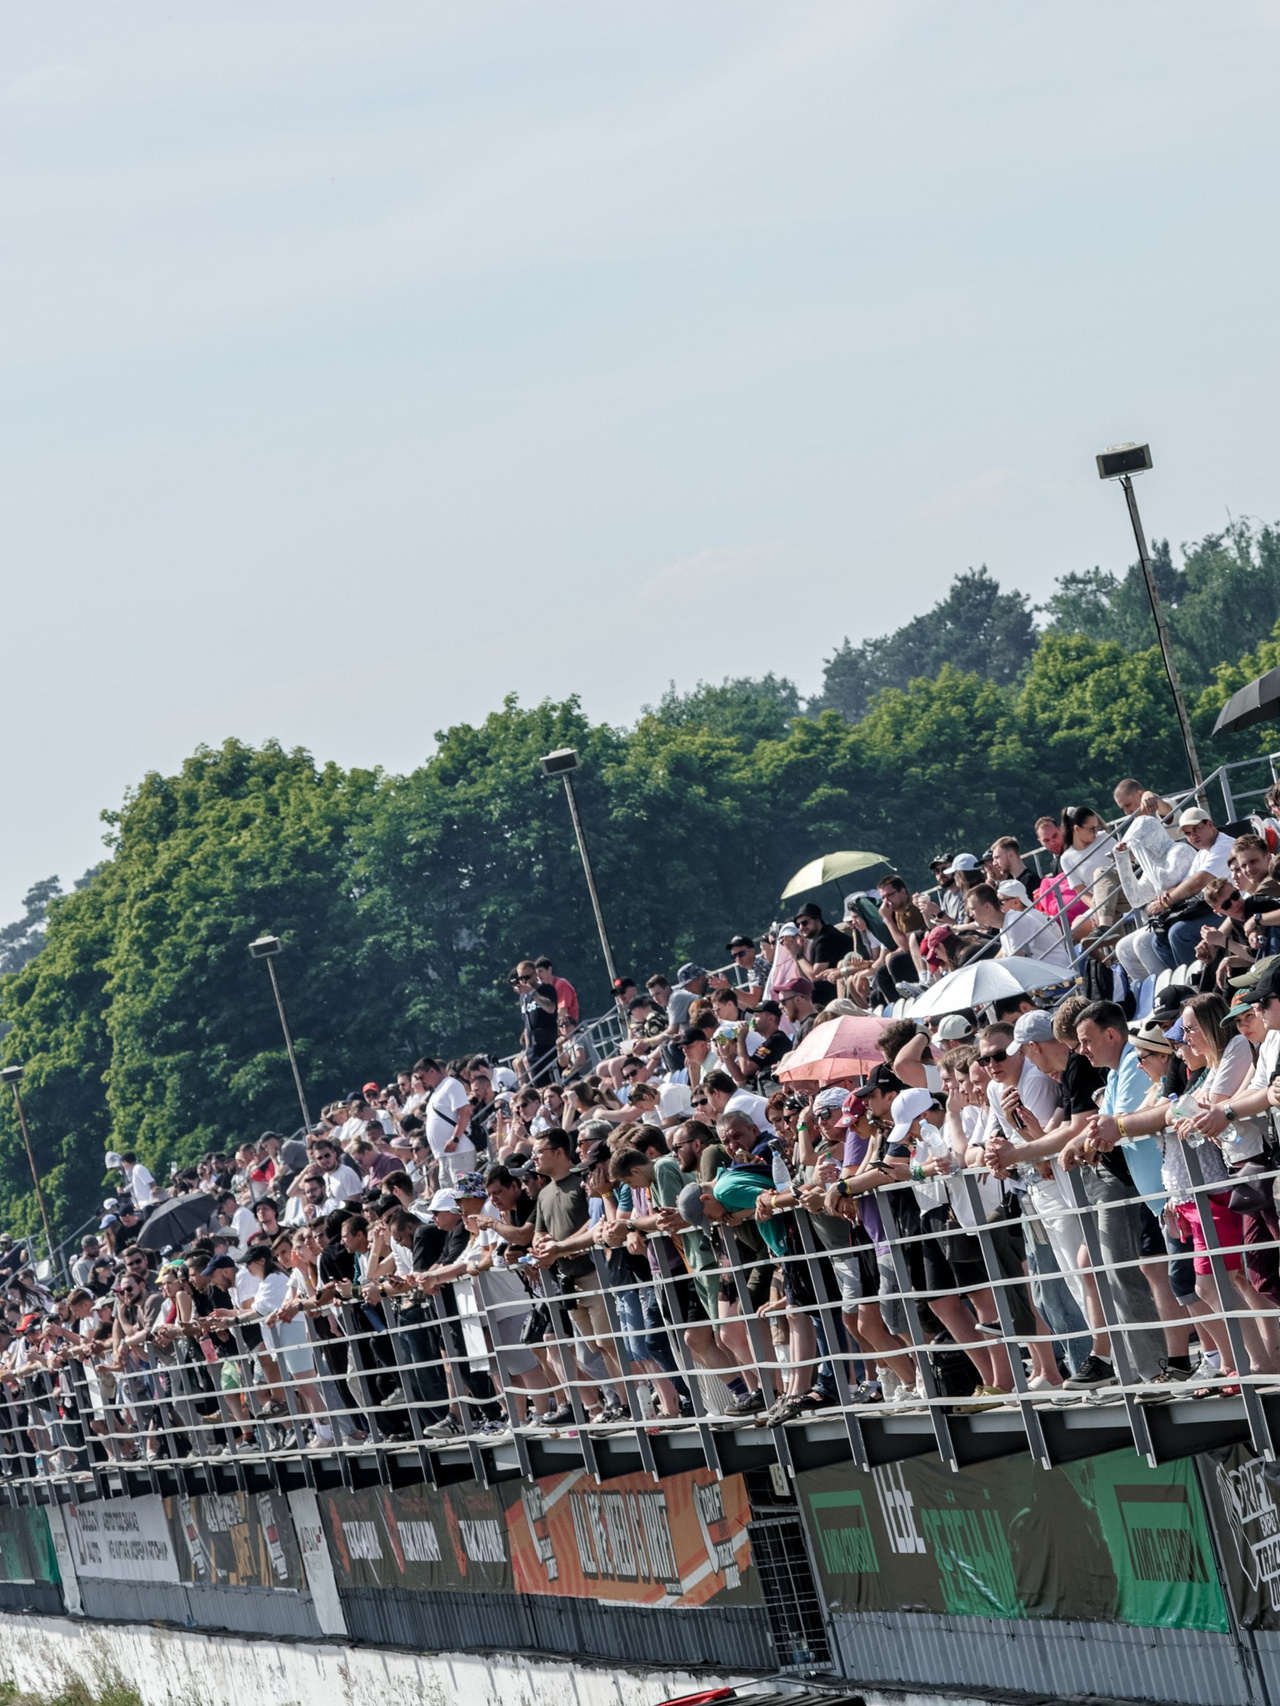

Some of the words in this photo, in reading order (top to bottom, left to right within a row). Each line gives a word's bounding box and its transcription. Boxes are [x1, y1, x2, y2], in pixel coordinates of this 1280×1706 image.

[700, 1482, 724, 1523] DRIFT
[1230, 1457, 1274, 1521] DRIFT
[568, 1491, 598, 1575] ALL
[638, 1491, 680, 1579] DRIFT
[1259, 1514, 1277, 1538] EXPO
